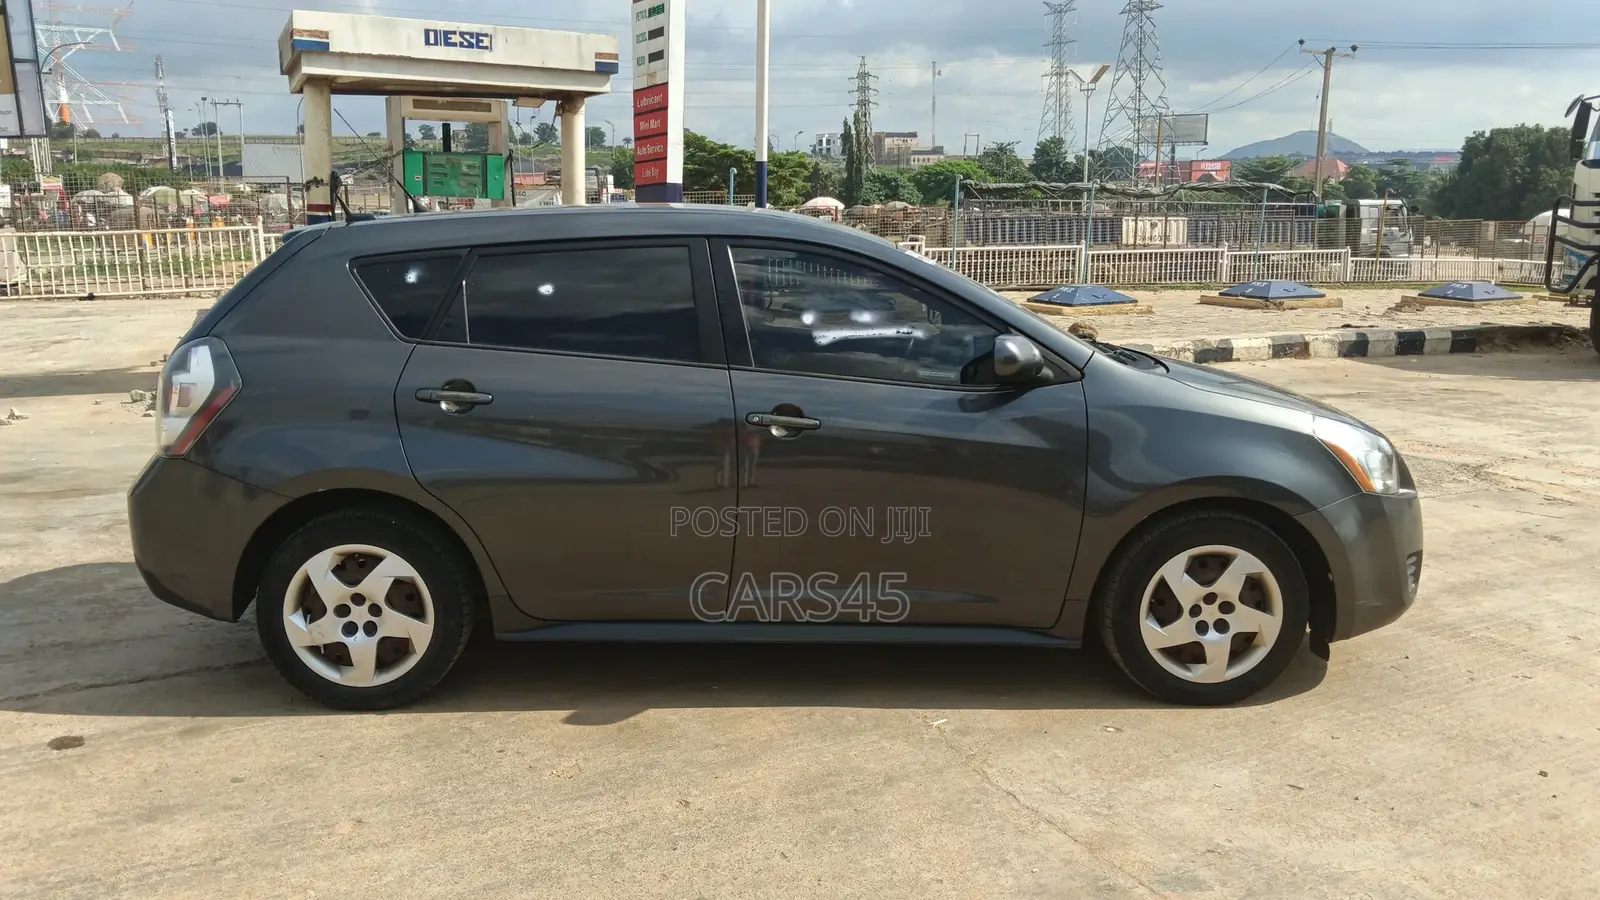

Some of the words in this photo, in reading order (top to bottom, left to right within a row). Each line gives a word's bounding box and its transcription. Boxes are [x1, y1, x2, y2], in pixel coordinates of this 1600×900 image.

[637, 93, 663, 108] Lubricant
[639, 120, 649, 131] Mini
[650, 118, 661, 129] Mart
[636, 146, 647, 156] Auto
[647, 143, 664, 155] Service
[1138, 234, 1170, 242] DANGOE
